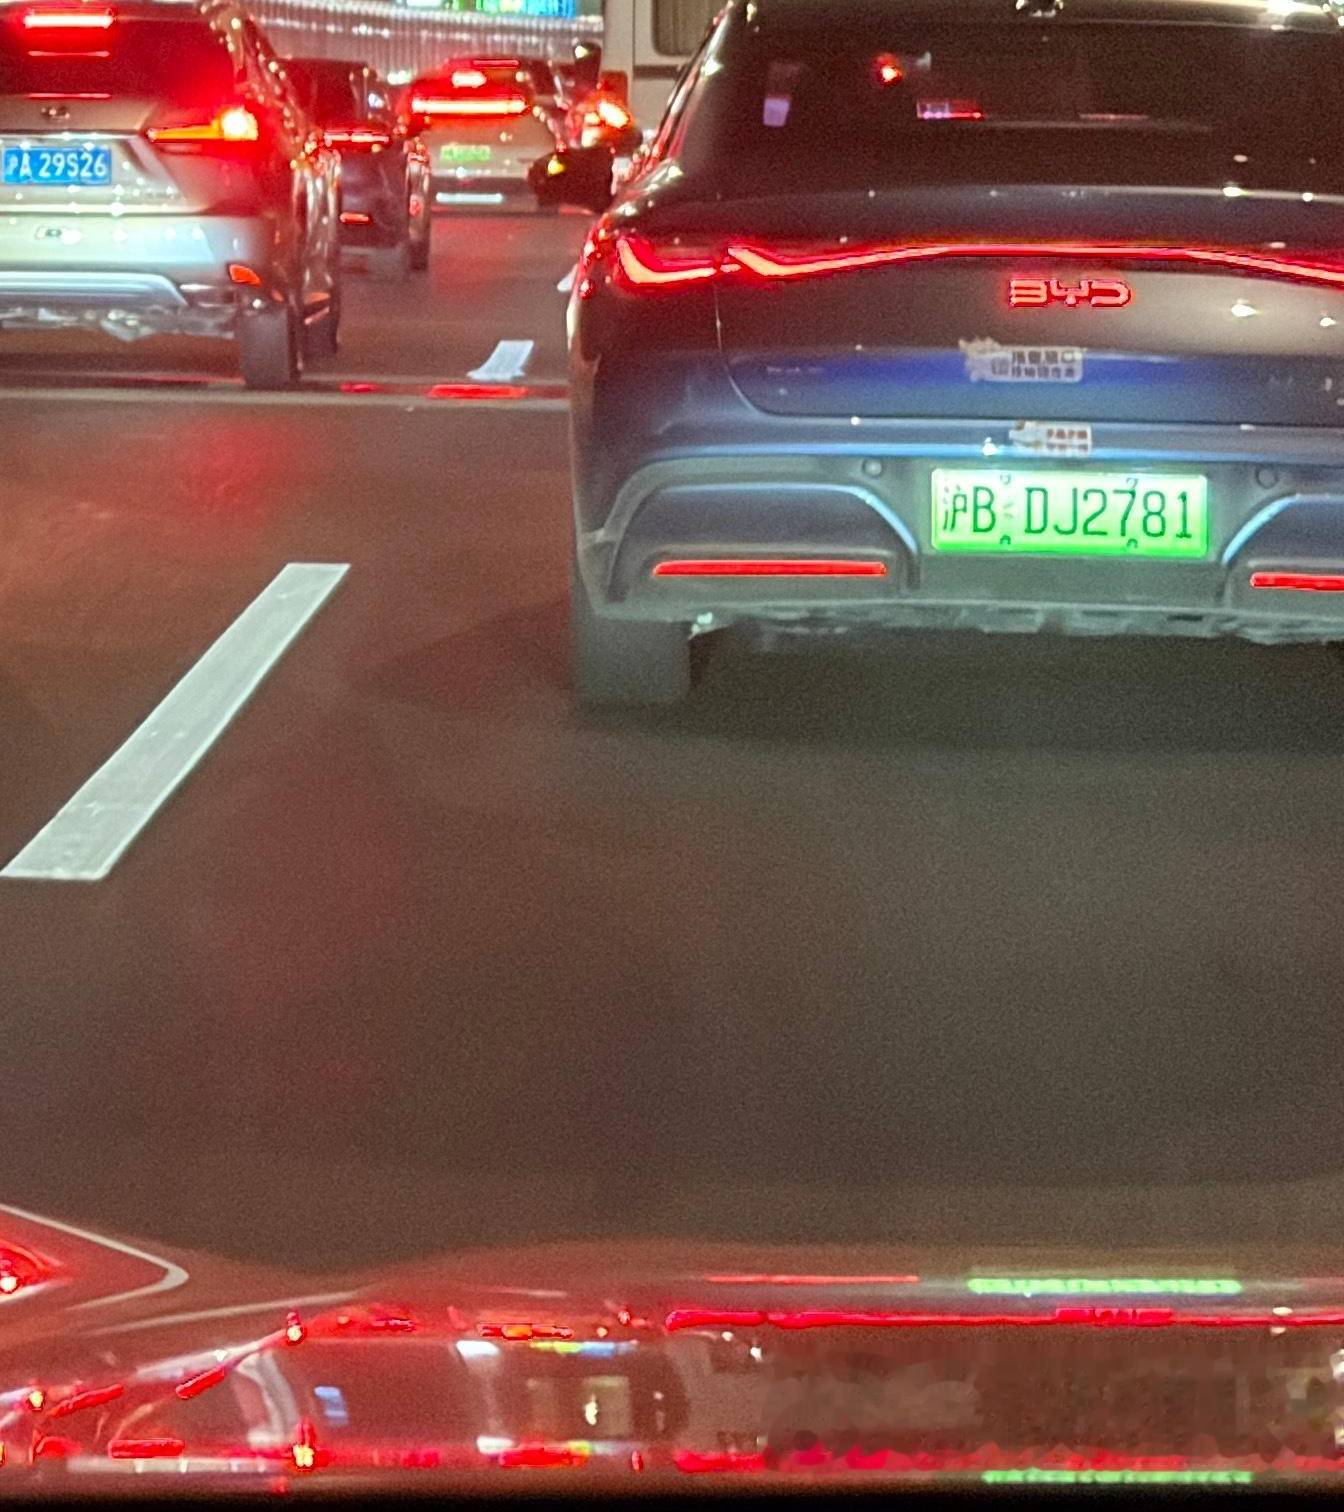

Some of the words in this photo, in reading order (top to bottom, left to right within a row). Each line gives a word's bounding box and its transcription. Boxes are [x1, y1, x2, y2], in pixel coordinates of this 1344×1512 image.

[1010, 279, 1131, 307] BYD
[943, 484, 996, 534] 沪B
[1024, 486, 1192, 539] DJ2781
